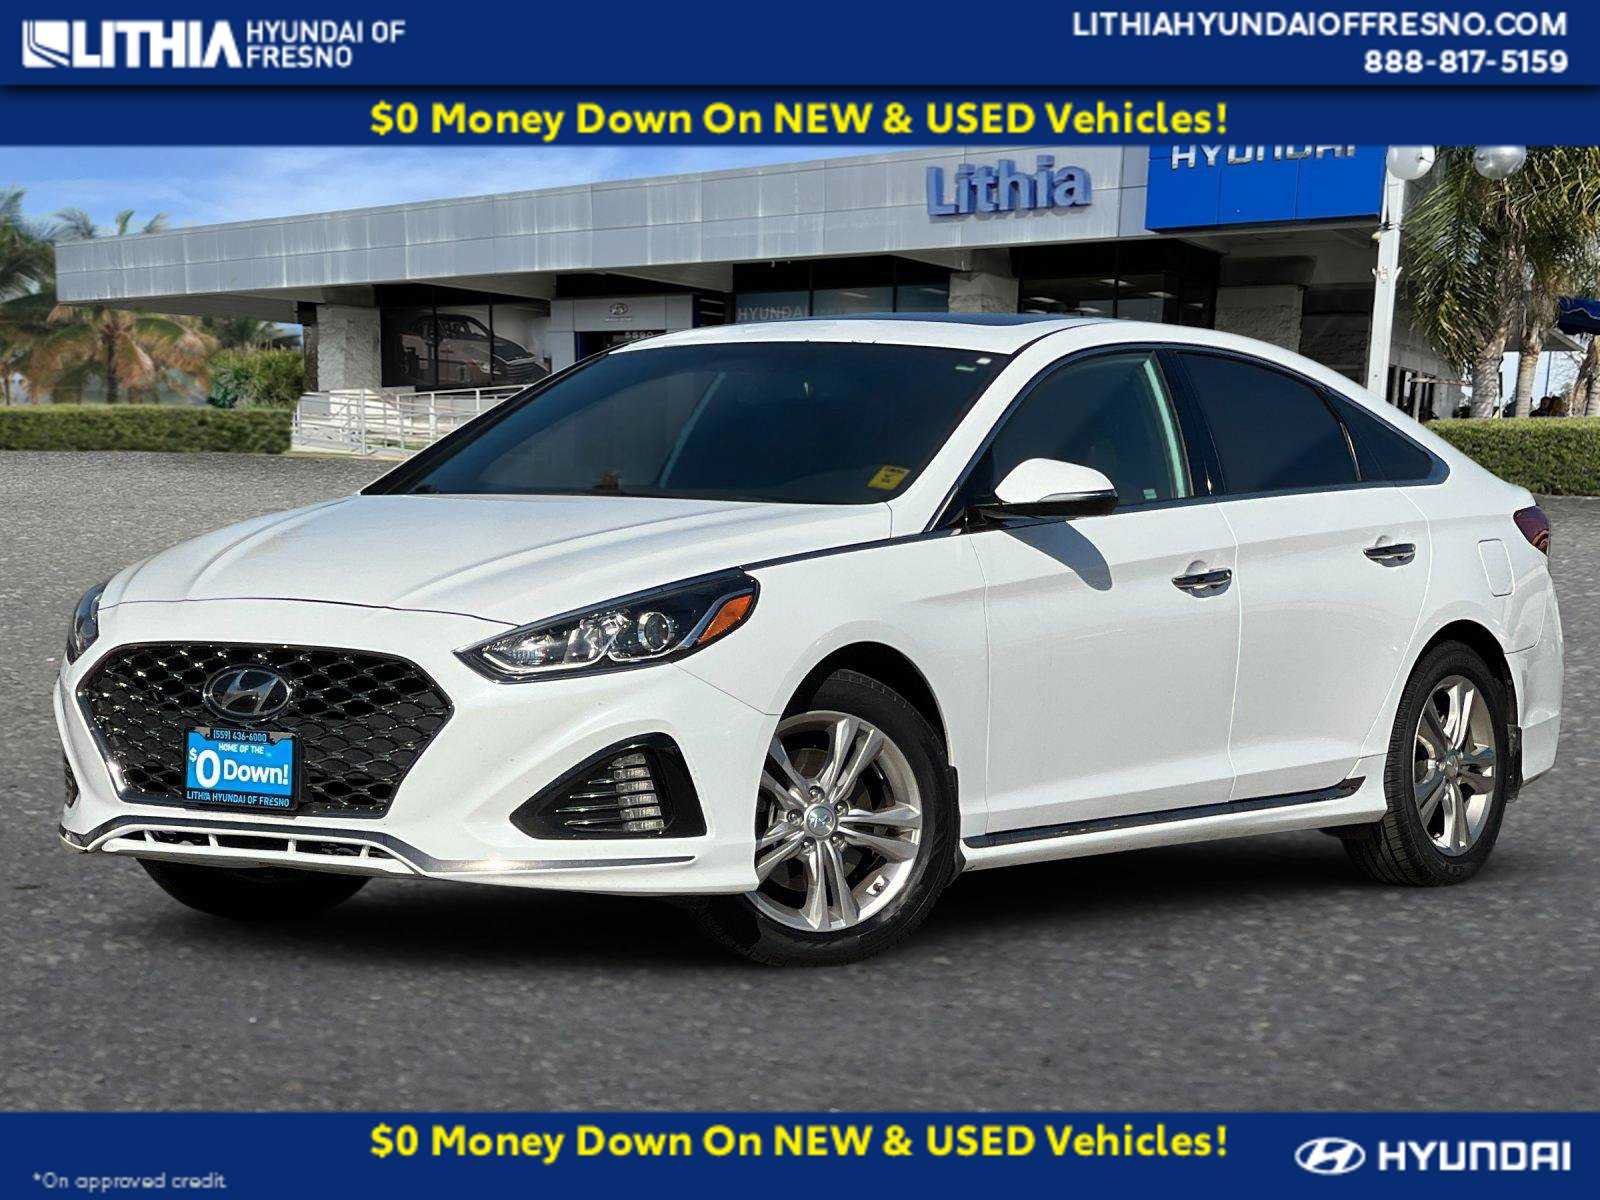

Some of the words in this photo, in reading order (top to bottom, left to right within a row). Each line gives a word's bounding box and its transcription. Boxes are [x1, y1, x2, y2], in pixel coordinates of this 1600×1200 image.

[926, 155, 1092, 217] Lithia
[218, 743, 239, 753] HOME
[239, 744, 250, 754] OF
[251, 745, 265, 755] THE
[223, 758, 289, 786] Down!
[186, 790, 212, 801] LITHIA
[212, 792, 246, 804] HYUNDAI
[247, 794, 258, 805] OF
[259, 796, 290, 807] FRESNO
